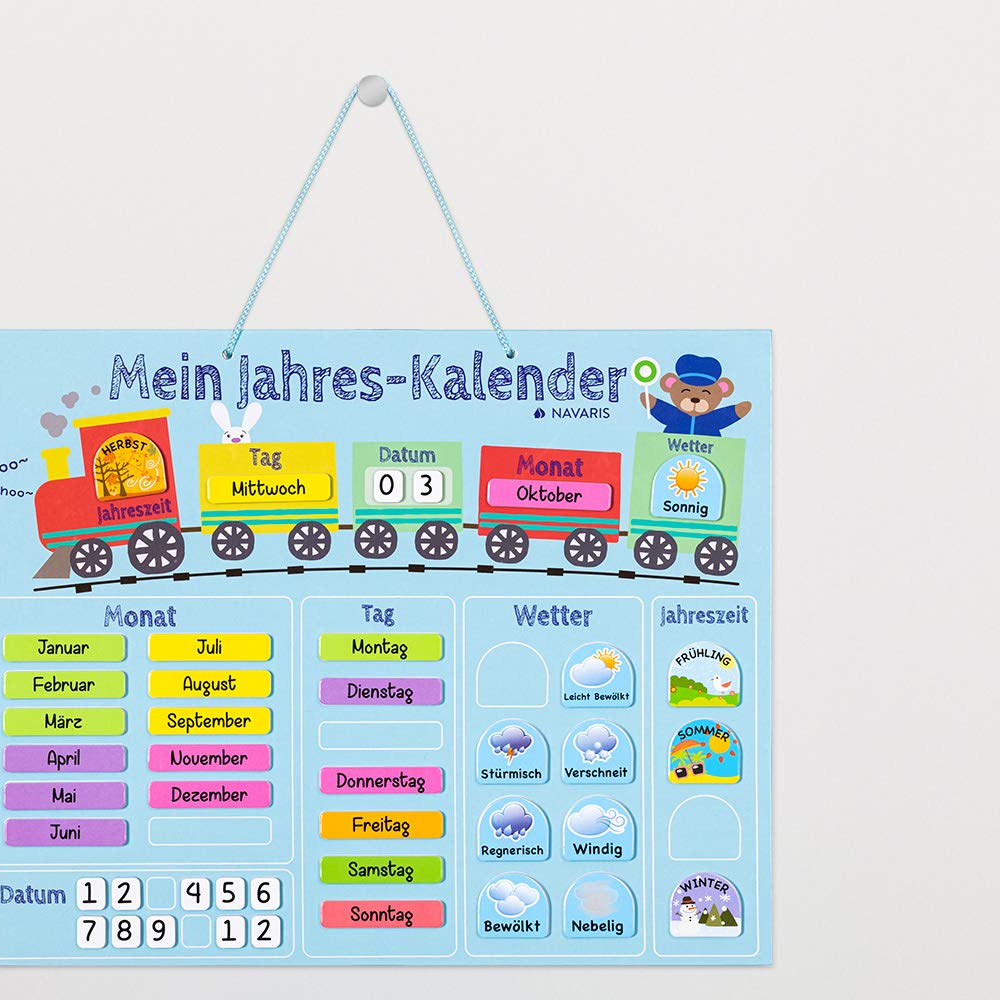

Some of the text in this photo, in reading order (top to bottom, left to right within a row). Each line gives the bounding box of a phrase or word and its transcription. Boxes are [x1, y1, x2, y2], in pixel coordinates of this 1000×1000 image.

[110, 350, 626, 409] Mein Jahres-Kalender
[552, 407, 610, 419] NAVARIS
[101, 439, 147, 456] HERBST
[379, 446, 436, 463] Datum
[667, 438, 714, 454] Wetter
[249, 447, 282, 471] Tag
[516, 455, 584, 478] Monat
[232, 479, 306, 497] Mittwoch
[516, 485, 582, 504] Oktober
[97, 498, 172, 524] Jahreszeit
[663, 500, 708, 517] Sonnig
[104, 605, 177, 627] Monat
[361, 604, 395, 627] Tag
[513, 604, 593, 627] Wetter
[660, 605, 749, 628] Jahreszeit
[38, 639, 90, 655] Januar
[197, 638, 222, 655] Juli
[352, 639, 408, 660] Montag
[675, 648, 732, 667] FRÜHLING
[33, 675, 95, 692] Februar
[183, 675, 236, 696] August
[347, 683, 414, 704] Dienstag
[564, 692, 629, 701] Leicht Bewölkt
[45, 714, 82, 729] März
[167, 713, 251, 733] September
[677, 726, 730, 743] SOMMER
[47, 749, 81, 770] April
[170, 749, 248, 766] November
[481, 768, 542, 779] Stürmisch
[564, 767, 628, 779] Verschneit
[336, 773, 425, 794] Donnerstag
[52, 788, 76, 803] Mai
[171, 787, 248, 802] Dezember
[50, 824, 81, 840] Juni
[352, 817, 410, 838] Freitag
[481, 845, 544, 857] Regnerisch
[573, 843, 622, 858] Windig
[348, 861, 414, 883] Samstag
[82, 881, 270, 903] 1 2 4 5 6
[679, 877, 729, 894] WINTER
[0, 885, 66, 905] Datum
[351, 906, 413, 927] Sonntag
[83, 919, 272, 941] 7 8 9 1 2
[484, 920, 541, 933] Bewölkt
[572, 920, 623, 935] Nebelig
